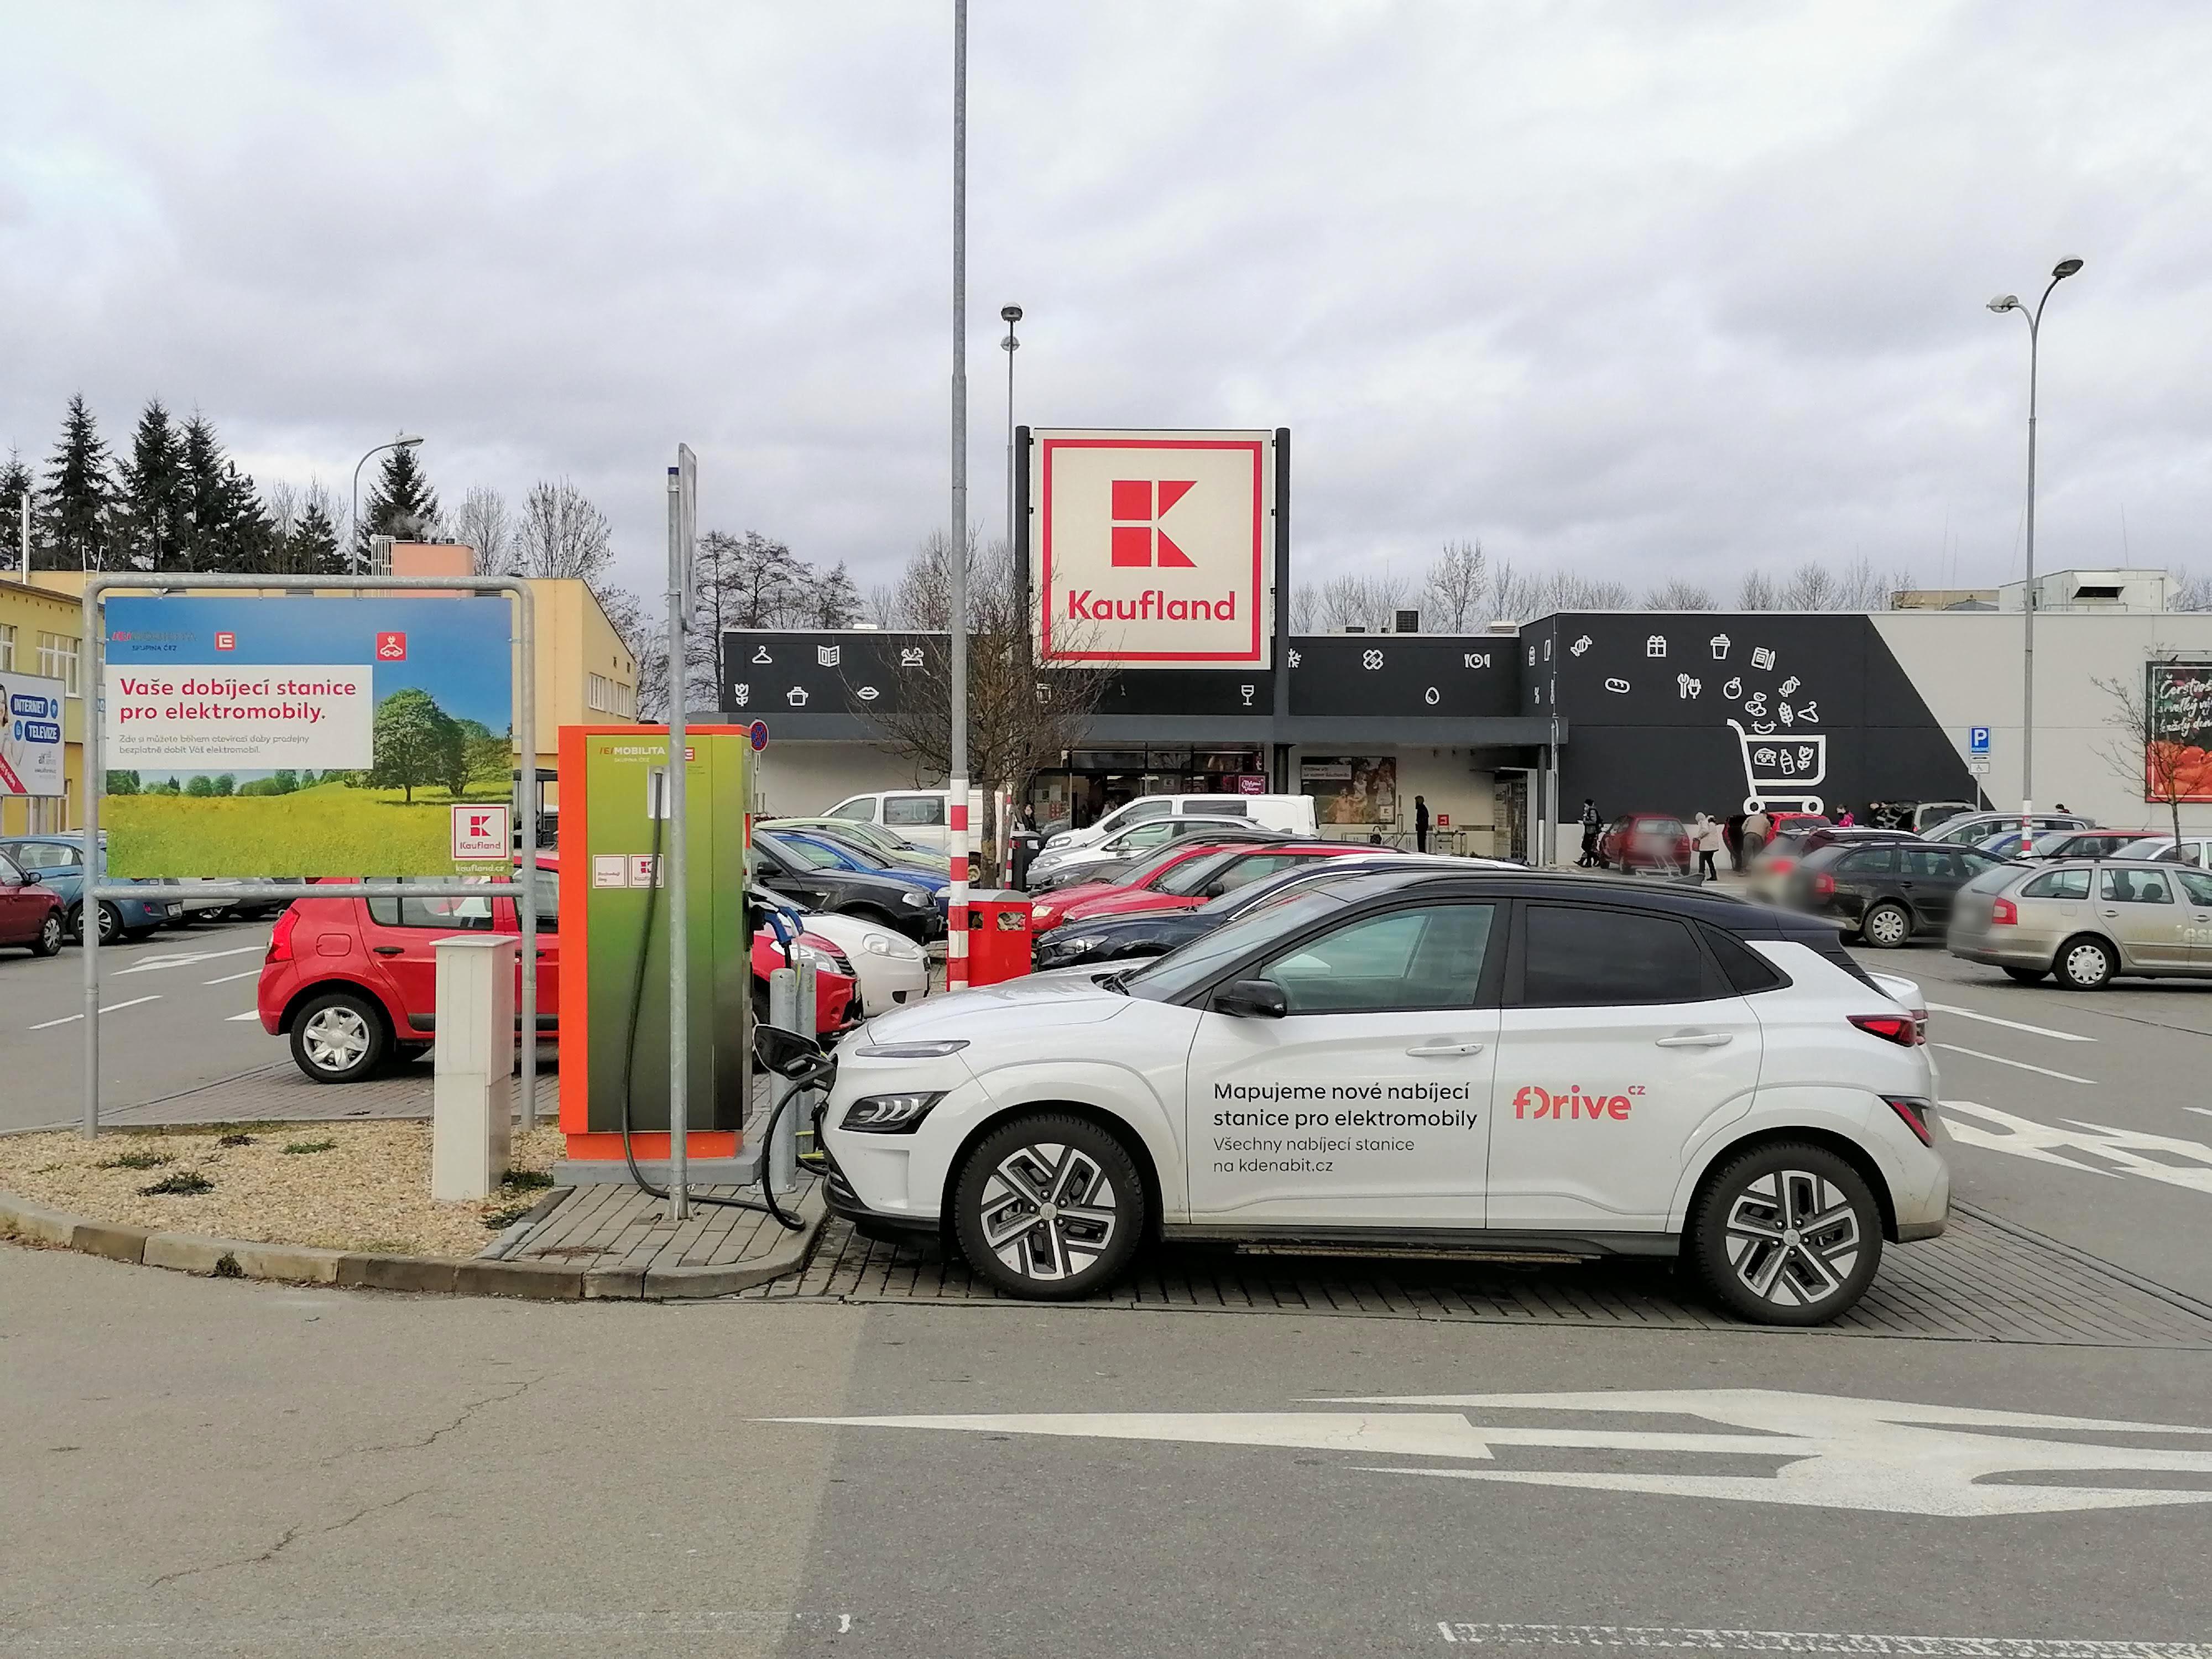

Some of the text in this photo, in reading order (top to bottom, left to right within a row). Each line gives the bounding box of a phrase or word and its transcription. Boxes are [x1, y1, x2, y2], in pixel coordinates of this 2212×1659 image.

[1068, 589, 1235, 621] Kaufland
[120, 679, 357, 700] Vaše dobíjecí stanice
[14, 698, 45, 714] INTERNET
[119, 702, 326, 723] pro elektromobily.
[28, 724, 58, 740] TELEVIZE
[1974, 729, 1987, 746] P
[460, 841, 500, 849] Kaufland
[1214, 1082, 1472, 1103] Mapujeme nové nabíjecí
[1213, 1109, 1478, 1130] stanice pro elektromobily
[1214, 1136, 1415, 1154] Všechny nabíjecí stanice
[1214, 1158, 1333, 1173] na kdenabit.cz
